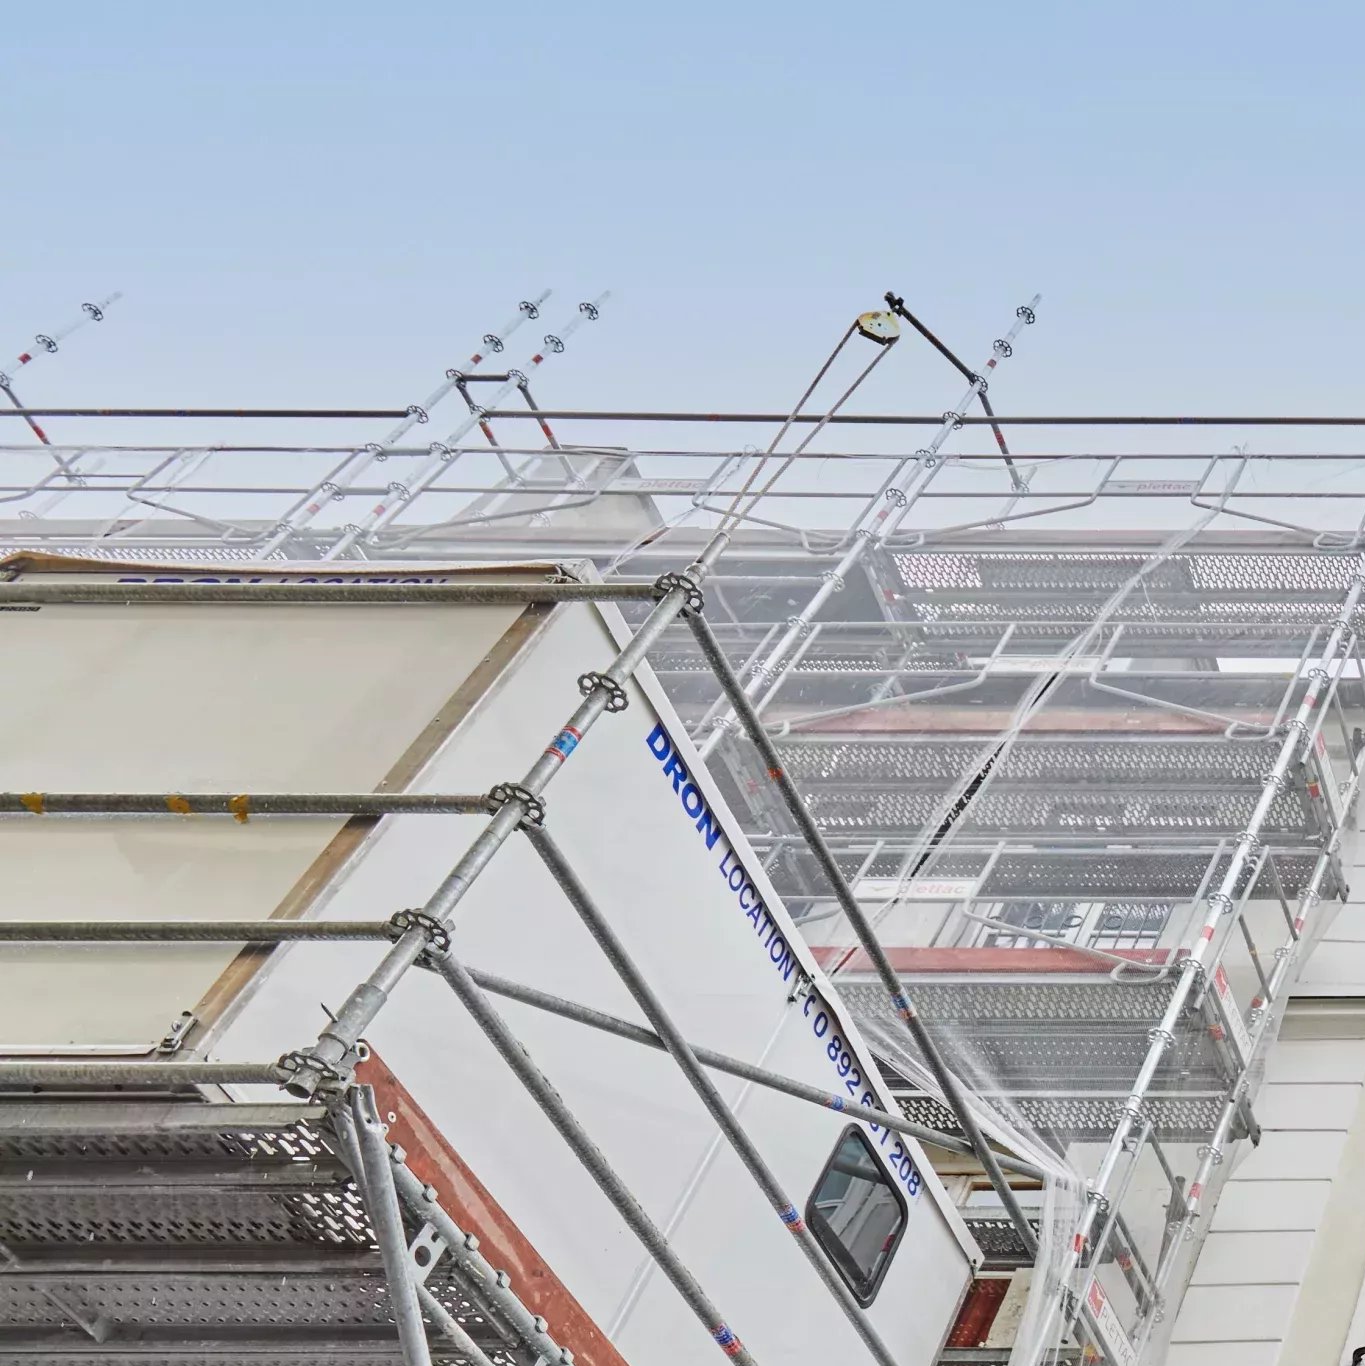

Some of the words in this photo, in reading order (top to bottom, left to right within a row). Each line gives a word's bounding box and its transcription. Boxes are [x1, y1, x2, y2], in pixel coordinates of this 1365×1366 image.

[646, 724, 721, 851] DRON
[719, 848, 796, 982] LOCATION
[813, 1010, 828, 1039] 0
[827, 1036, 863, 1097] 892
[888, 1138, 922, 1199] 208
